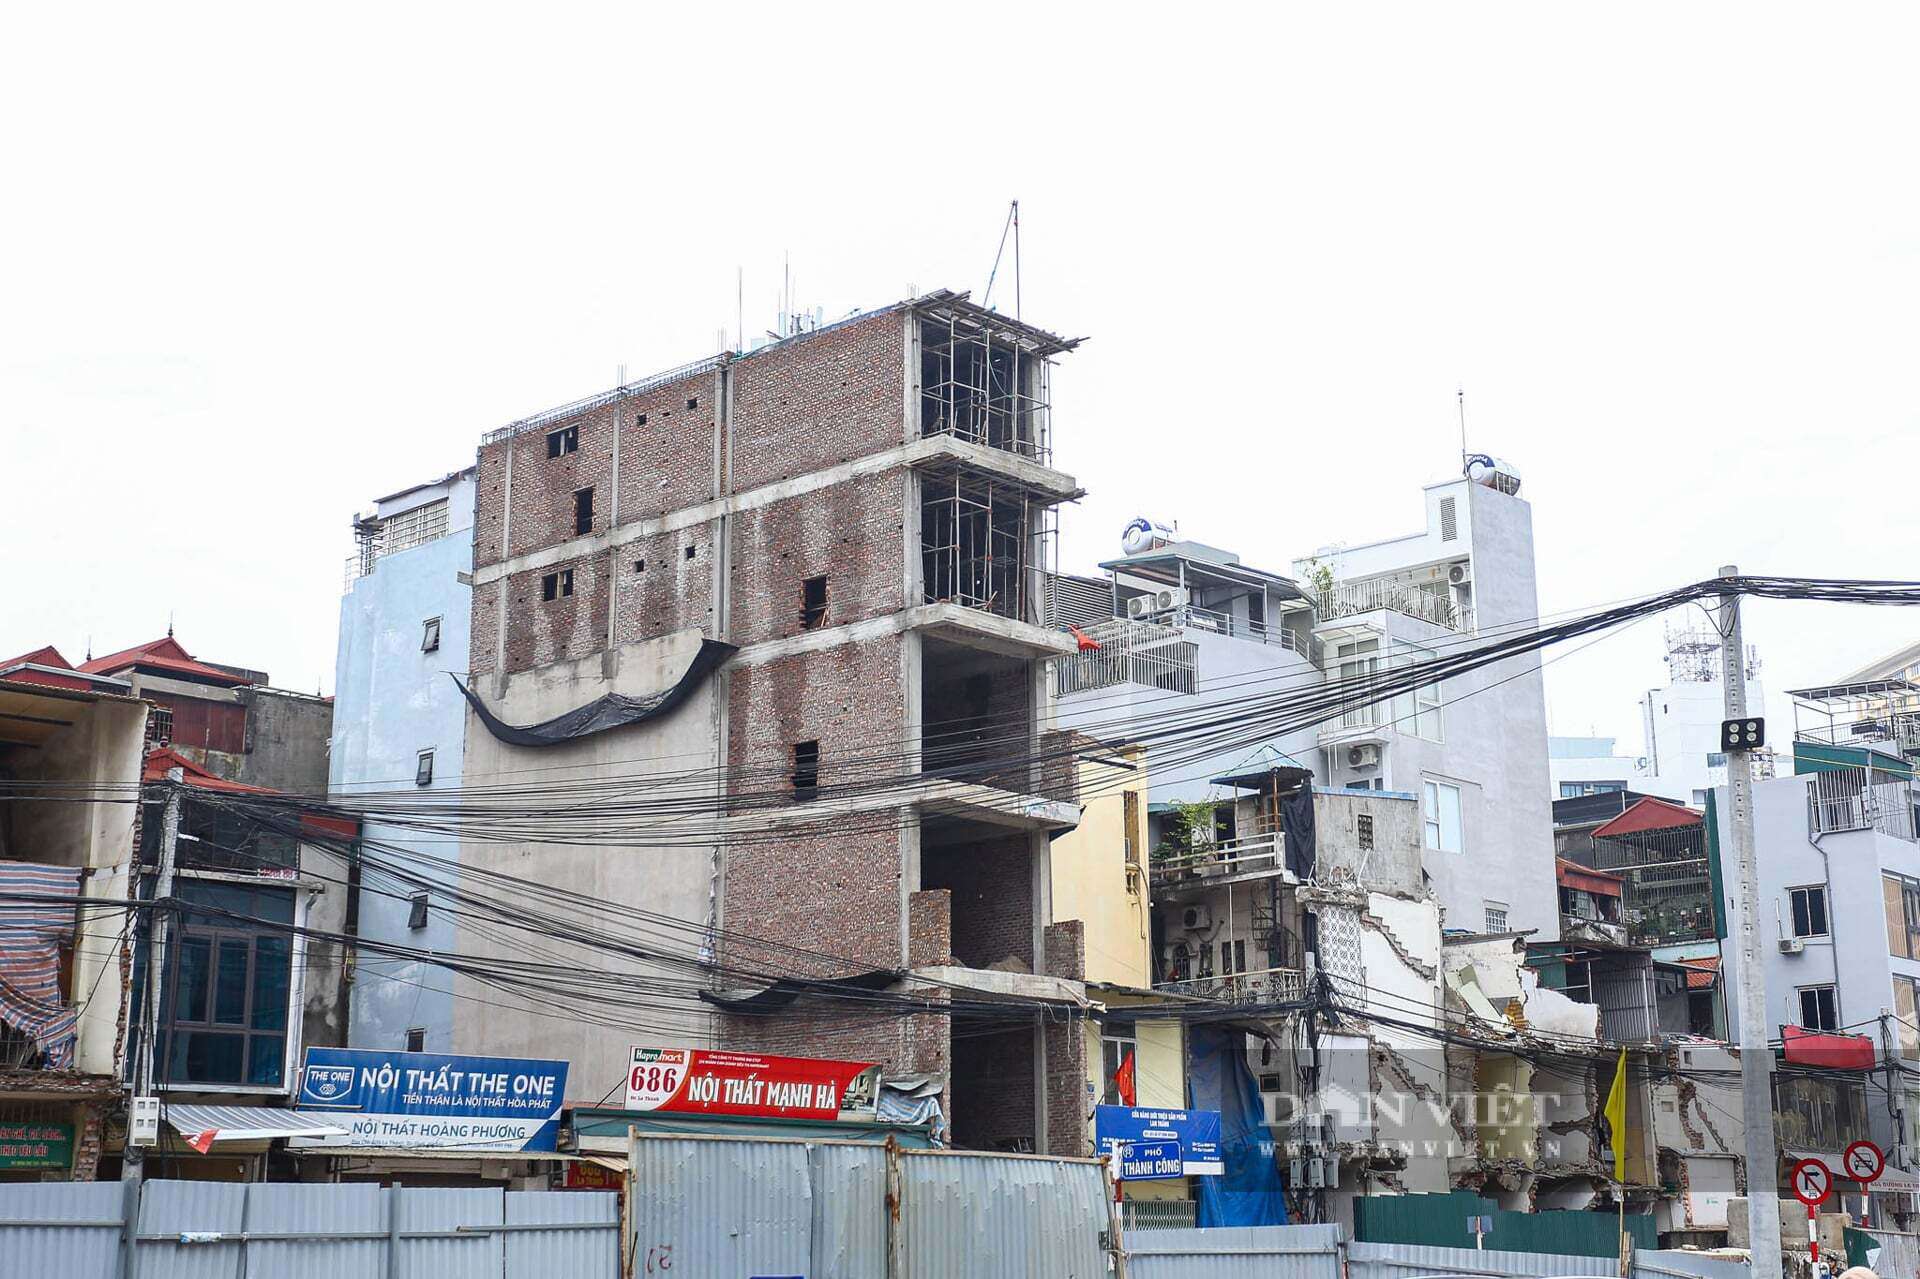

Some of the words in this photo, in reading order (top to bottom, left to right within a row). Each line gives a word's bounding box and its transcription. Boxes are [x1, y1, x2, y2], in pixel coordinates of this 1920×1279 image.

[311, 1071, 328, 1081] THE
[331, 1071, 351, 1081] ONE
[361, 1063, 400, 1094] NỘI
[406, 1064, 464, 1091] THẤT
[469, 1072, 509, 1093] THE
[513, 1075, 555, 1095] ONE
[631, 1066, 677, 1093] 686
[451, 1094, 463, 1106] LÀ
[528, 1098, 552, 1109] PHÁT
[688, 1072, 720, 1107] NỘI
[724, 1072, 765, 1105] THẤT
[766, 1081, 812, 1112] MẠNH
[815, 1079, 836, 1109] HÀ
[353, 1118, 377, 1137] NỘI
[382, 1119, 418, 1136] THẤT
[421, 1121, 467, 1137] HOÀNG
[471, 1124, 525, 1139] PHƯƠNG
[1144, 1146, 1162, 1157] PHỐ
[1124, 1159, 1153, 1175] THÀNH
[1155, 1157, 1180, 1174] CÔNG
